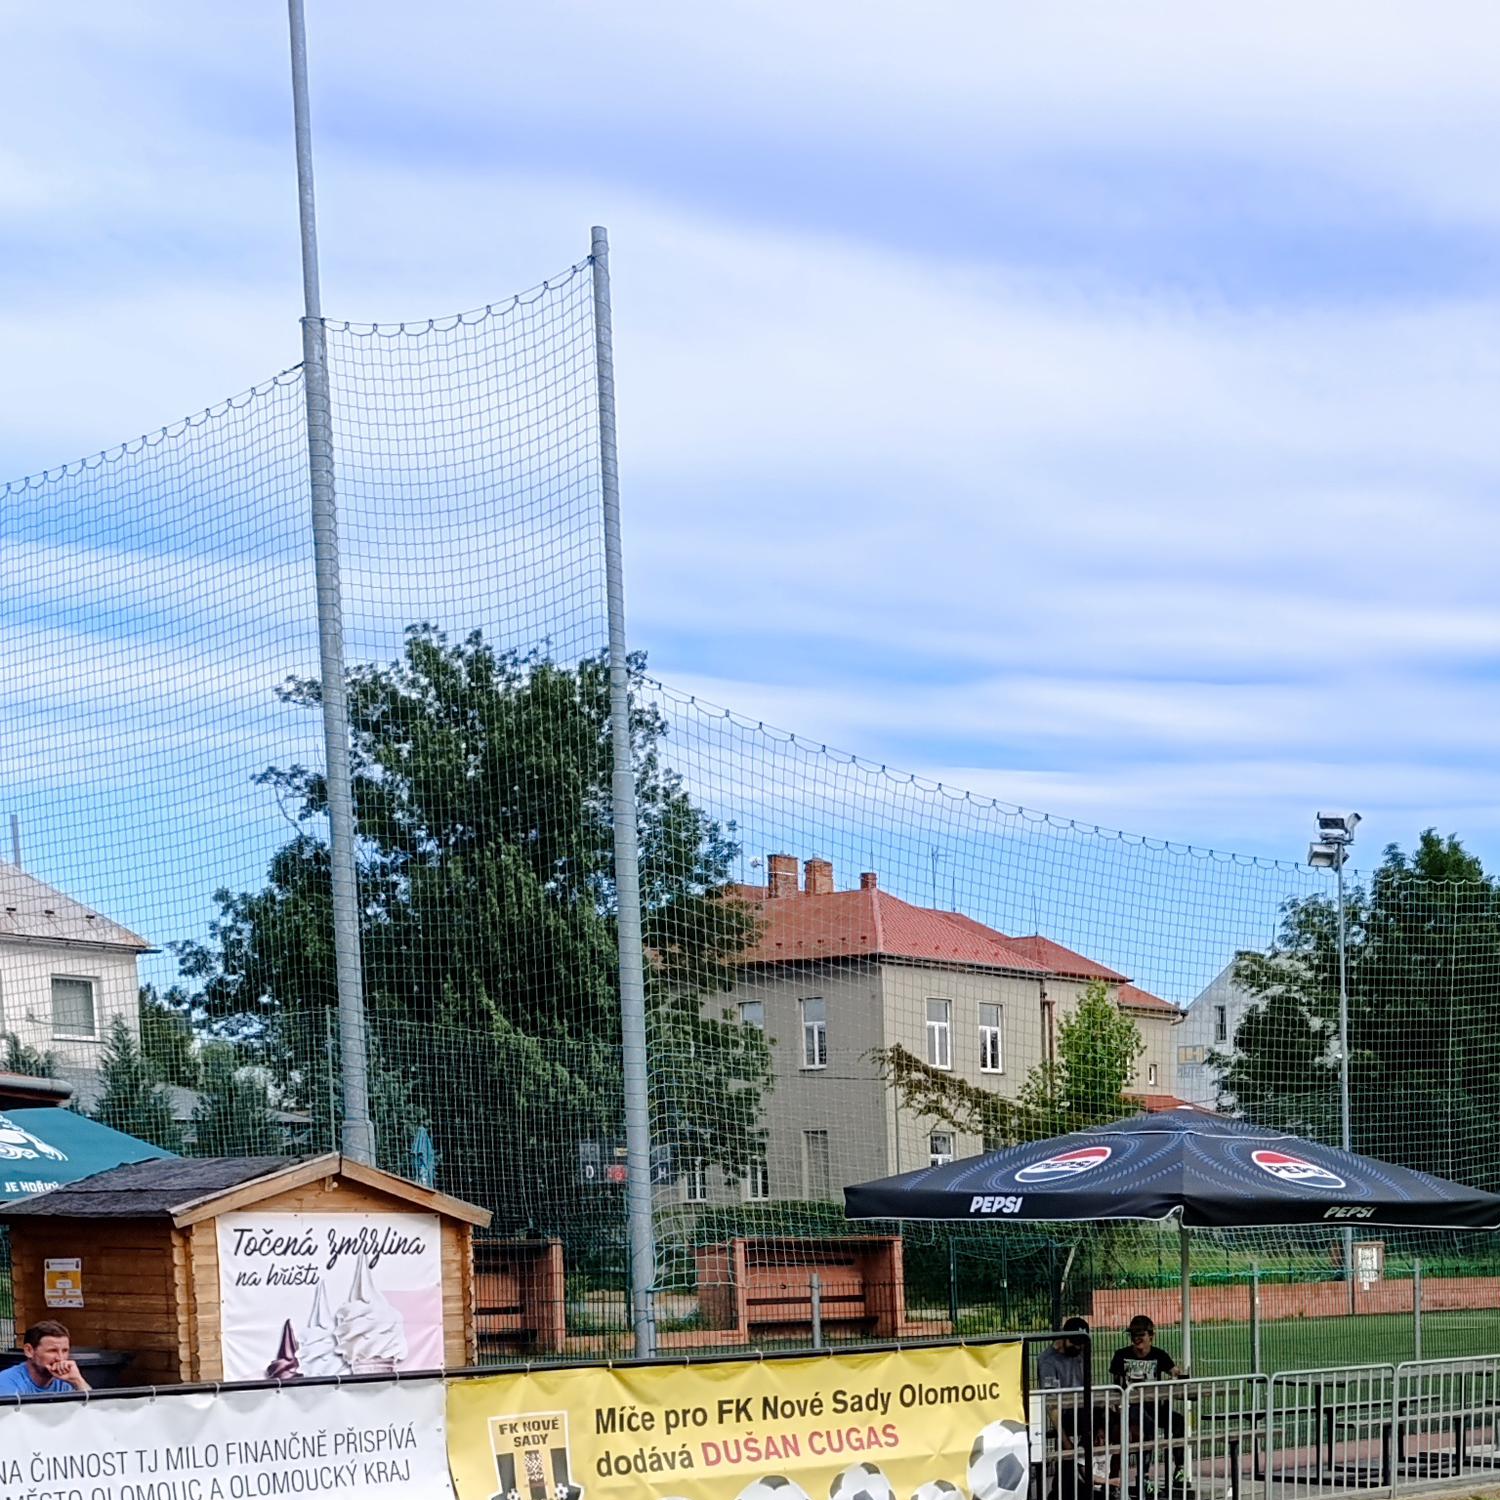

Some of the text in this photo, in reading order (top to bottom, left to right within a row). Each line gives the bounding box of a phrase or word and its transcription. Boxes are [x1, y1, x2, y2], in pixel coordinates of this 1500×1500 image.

[4, 1181, 20, 1192] JE
[969, 1196, 1023, 1213] PEPSI
[1323, 1206, 1377, 1219] PEPSI
[233, 1227, 425, 1270] Točená zmrzlina
[235, 1263, 320, 1286] na hřišti
[595, 1382, 1000, 1435] Míče pro FK Nové Sady Olomouc
[499, 1416, 560, 1435] FK NOVÉ
[30, 1451, 128, 1483] ČINNOST
[135, 1449, 158, 1473] TJ
[166, 1443, 219, 1471] MILO
[226, 1429, 328, 1465] FINANČNĚ
[334, 1421, 417, 1455] PŘISPÍVÁ
[513, 1433, 549, 1448] SADY
[596, 1423, 900, 1477] dodává DUŠAN CUGAS
[210, 1477, 224, 1500] A
[230, 1459, 357, 1499] OLOMOUCKÝ
[364, 1459, 411, 1484] KRAJ
